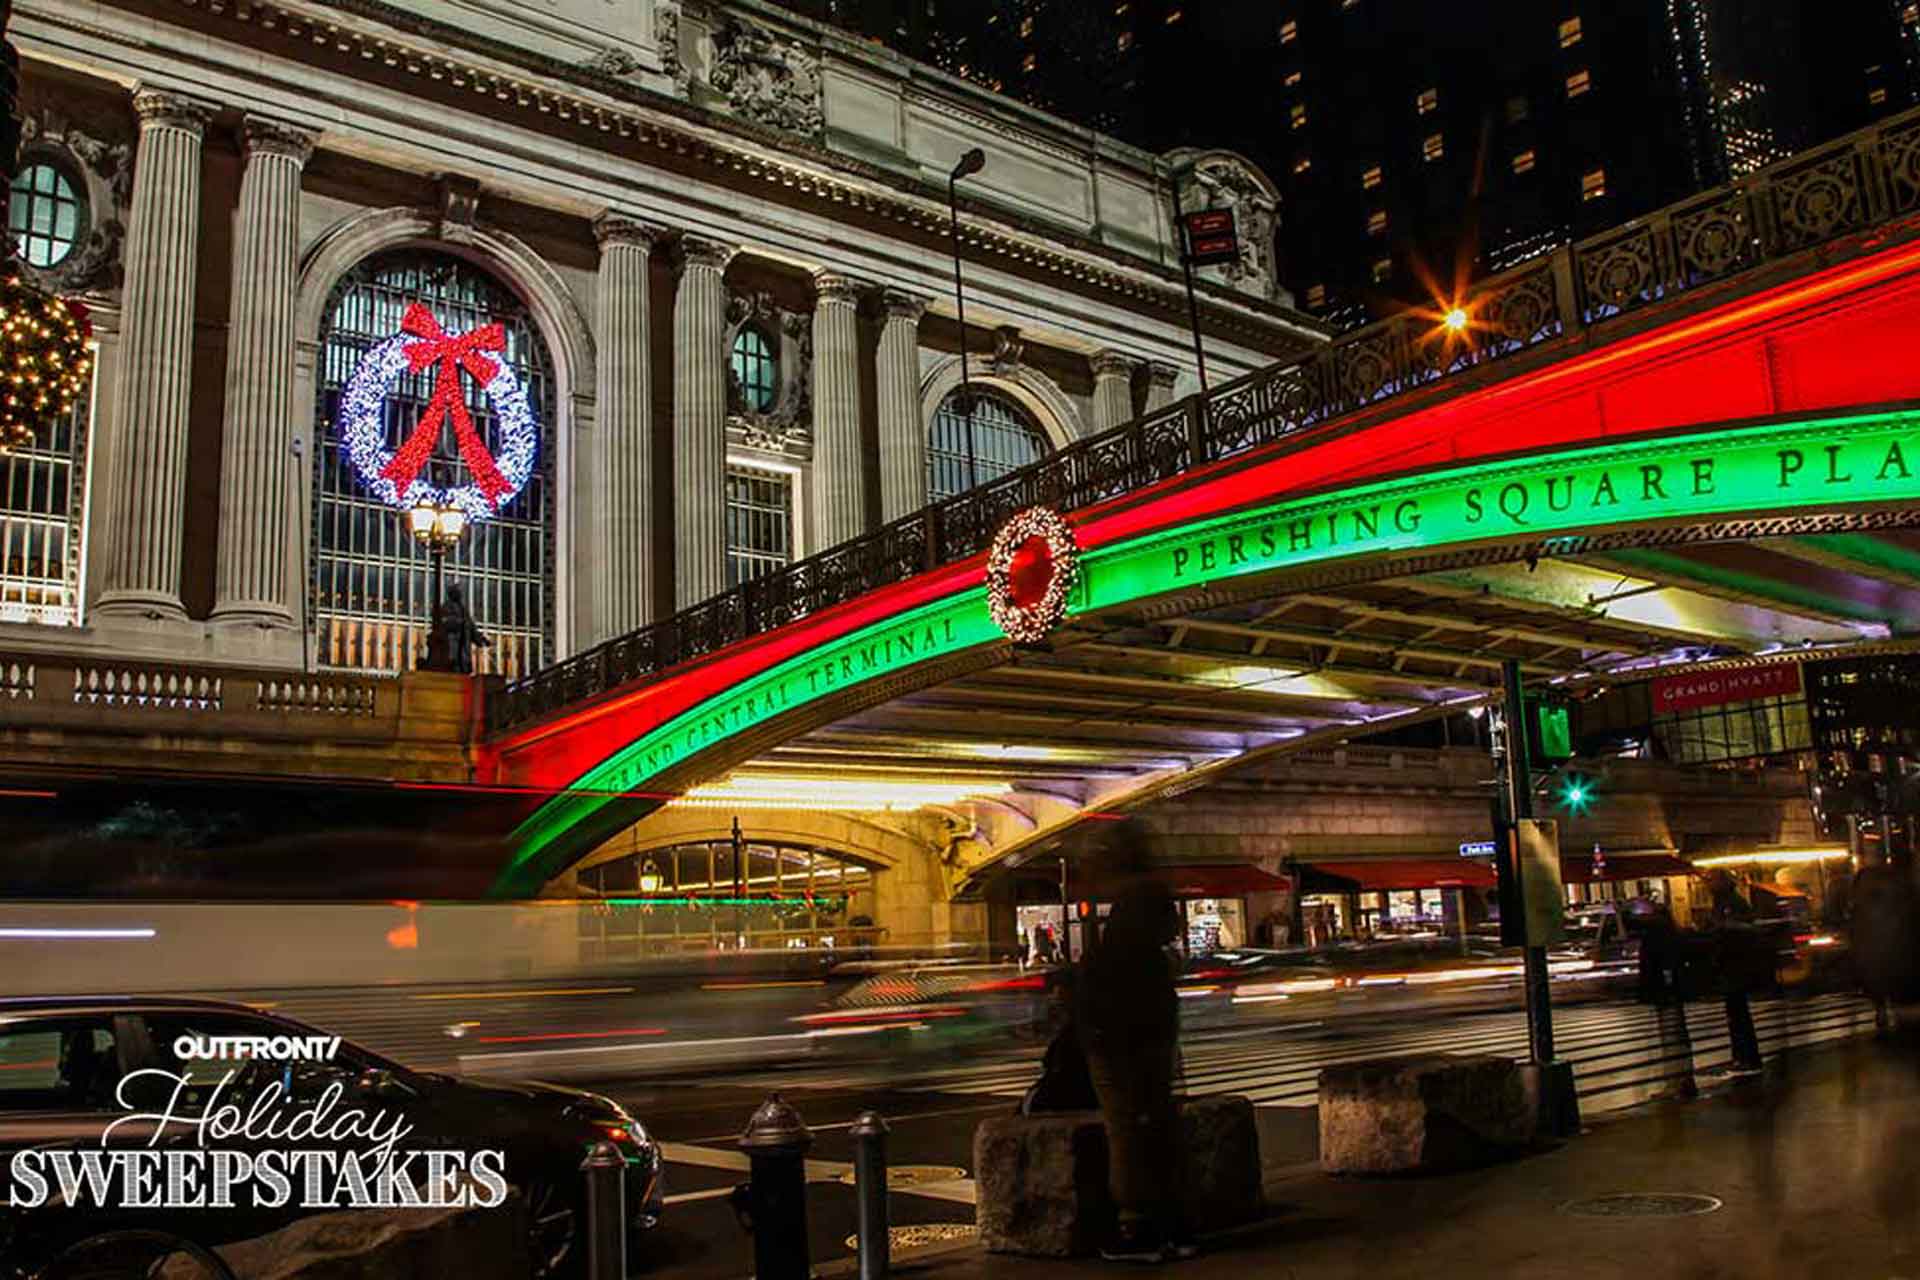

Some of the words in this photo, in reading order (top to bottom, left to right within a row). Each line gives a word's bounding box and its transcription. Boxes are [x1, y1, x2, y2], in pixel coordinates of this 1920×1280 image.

[1173, 499, 1422, 577] PERSHING
[1465, 457, 1715, 525] SQUARE
[1775, 440, 1912, 488] PLA
[608, 743, 675, 791] GRAND
[686, 683, 789, 747] CENTRAL
[806, 618, 957, 692] TERMINAL
[1663, 681, 1719, 700] GRAND
[1728, 671, 1784, 690] HYATT
